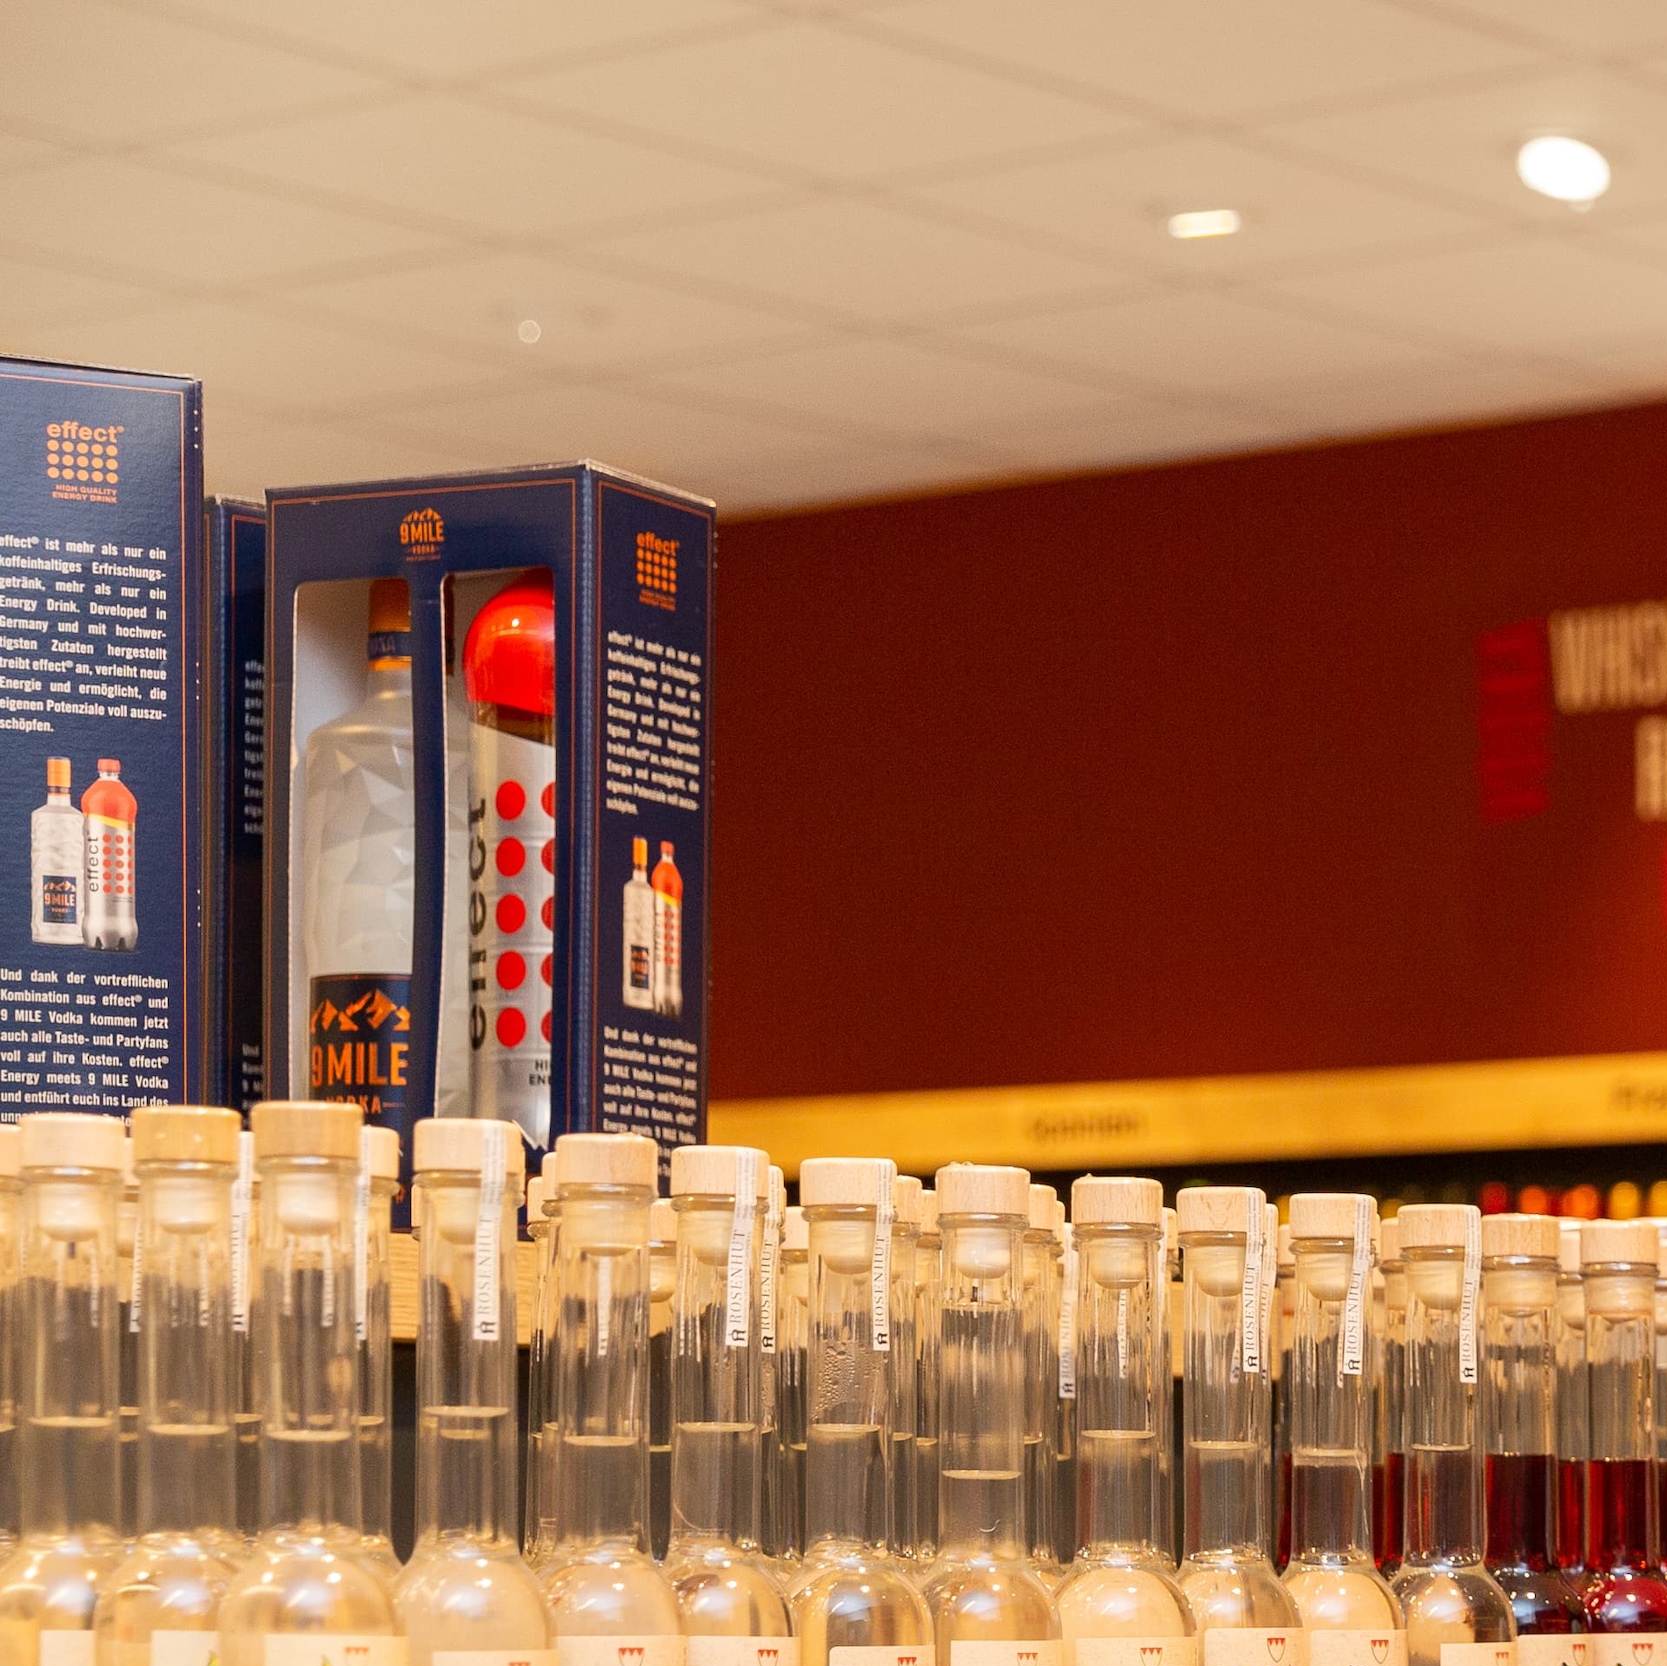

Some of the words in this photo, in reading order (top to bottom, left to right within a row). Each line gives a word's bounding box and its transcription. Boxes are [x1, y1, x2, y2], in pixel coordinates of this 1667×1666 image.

[45, 537, 59, 551] ist
[66, 541, 96, 554] mehr
[101, 543, 118, 556] als
[124, 546, 144, 558] nur
[149, 547, 167, 560] ein
[0, 555, 82, 574] koffeinhaltiges
[55, 580, 85, 593] mehr
[94, 583, 111, 596] als
[121, 586, 140, 598] nur
[149, 587, 167, 600] ein
[0, 595, 38, 612] Energy
[46, 598, 80, 613] Drink.
[89, 602, 147, 619] Developed
[156, 607, 167, 620] in
[0, 615, 49, 633] Germany
[58, 621, 79, 633] und
[88, 623, 106, 635] mit
[0, 636, 38, 650] tigsten
[51, 639, 94, 654] Zutaten
[107, 644, 167, 661] hergestellt
[0, 656, 30, 670] treibt
[95, 664, 137, 678] verleiht
[140, 668, 167, 681] neue
[0, 676, 42, 692] Energie
[50, 681, 71, 693] und
[78, 683, 142, 699] ermöglicht,
[149, 687, 167, 700] die
[0, 697, 43, 712] eigenen
[46, 699, 105, 716] Potenziale
[107, 705, 128, 717] voll
[0, 717, 54, 733] schöpfen.
[0, 968, 22, 981] Und
[30, 970, 58, 983] dank
[67, 972, 86, 984] der
[94, 974, 168, 989] vortrefflichen
[0, 989, 69, 1004] Kombination
[76, 995, 96, 1005] aus
[148, 997, 168, 1009] und
[1, 1009, 8, 1021] 9
[14, 1010, 42, 1023] MILE
[49, 1011, 83, 1025] Vodka
[90, 1013, 137, 1027] kommen
[143, 1016, 169, 1030] jetzt
[729, 1230, 745, 1324] ROSENHUT
[874, 1235, 886, 1328] ROSENHUT
